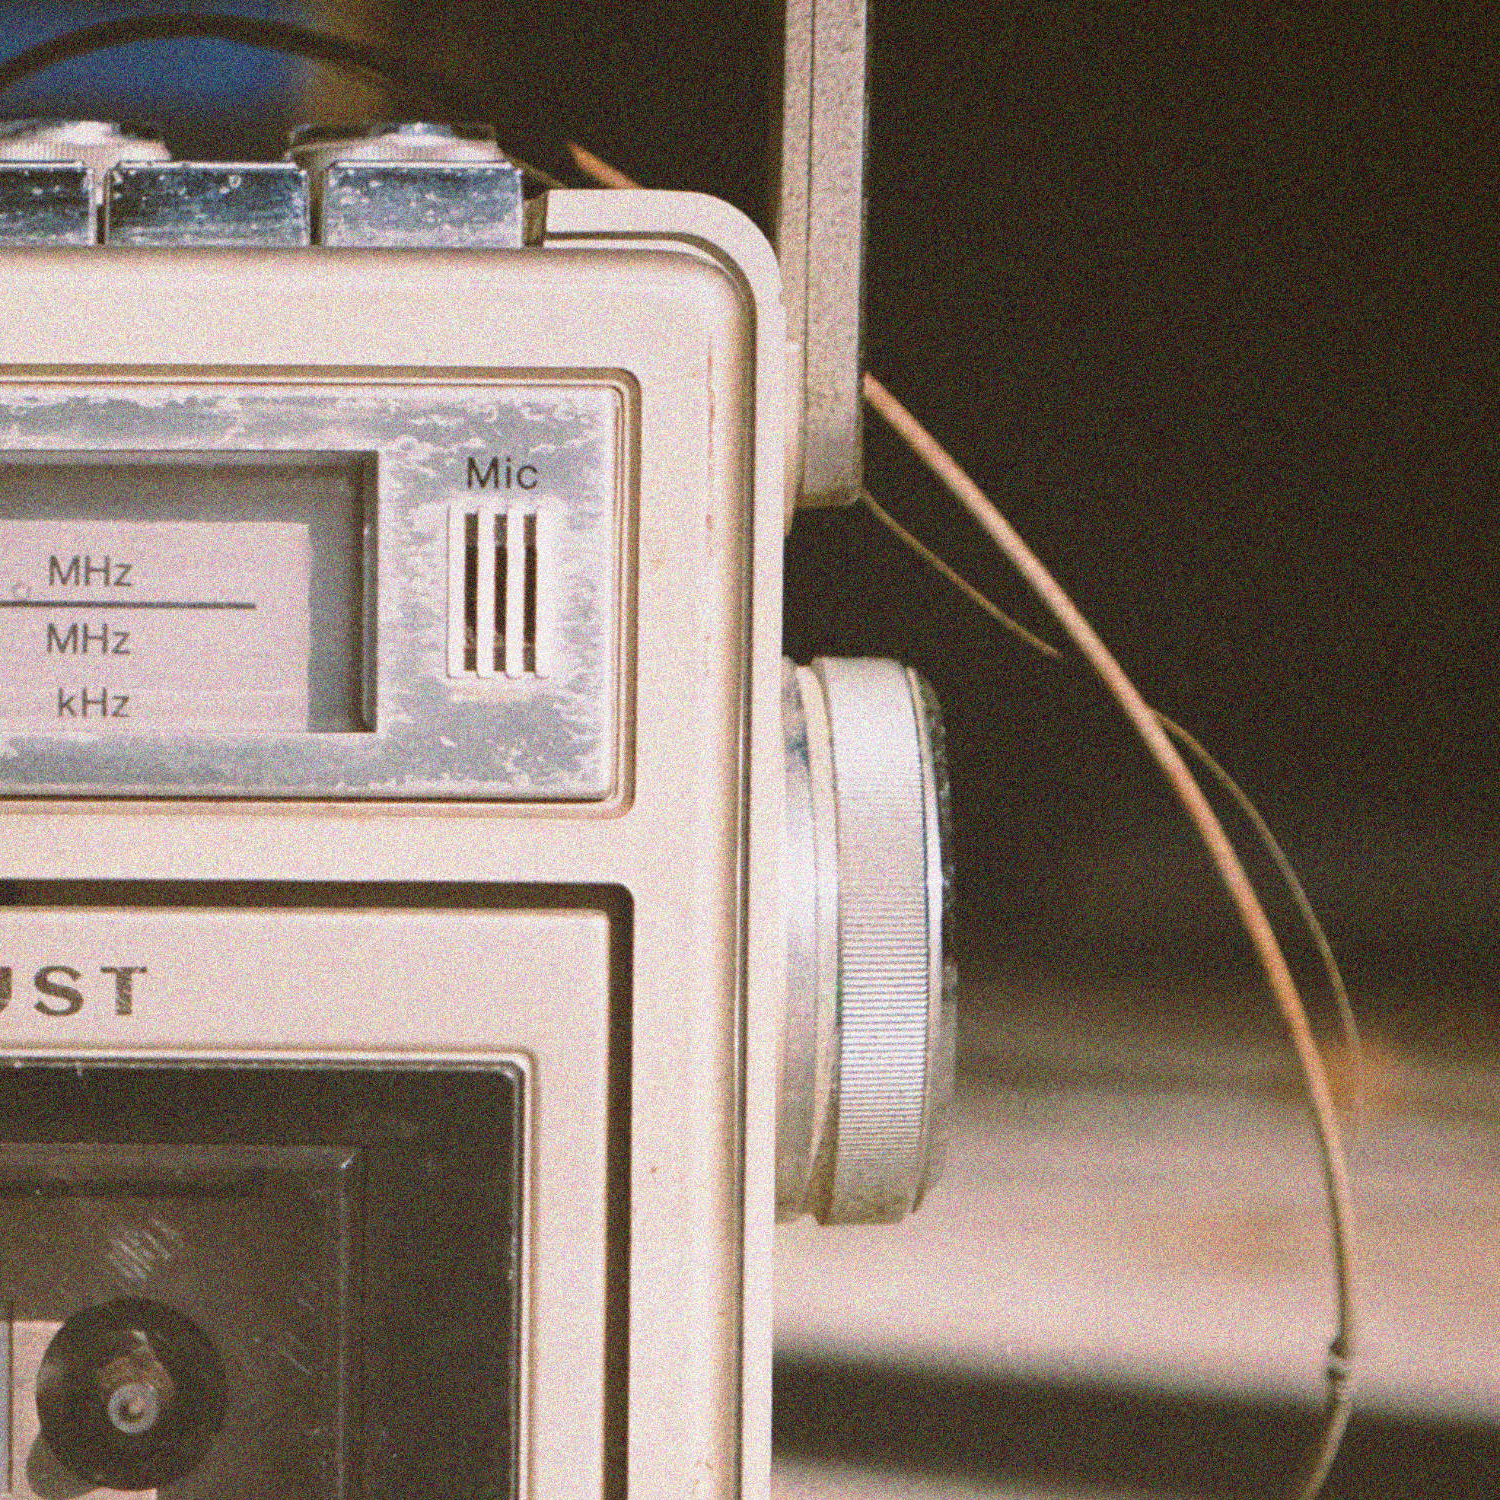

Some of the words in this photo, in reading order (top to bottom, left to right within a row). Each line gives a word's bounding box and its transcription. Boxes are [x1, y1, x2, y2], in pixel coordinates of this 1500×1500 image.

[465, 455, 540, 491] Mic
[47, 554, 134, 588] MHz
[46, 622, 132, 656] MHz
[56, 686, 132, 718] kHz
